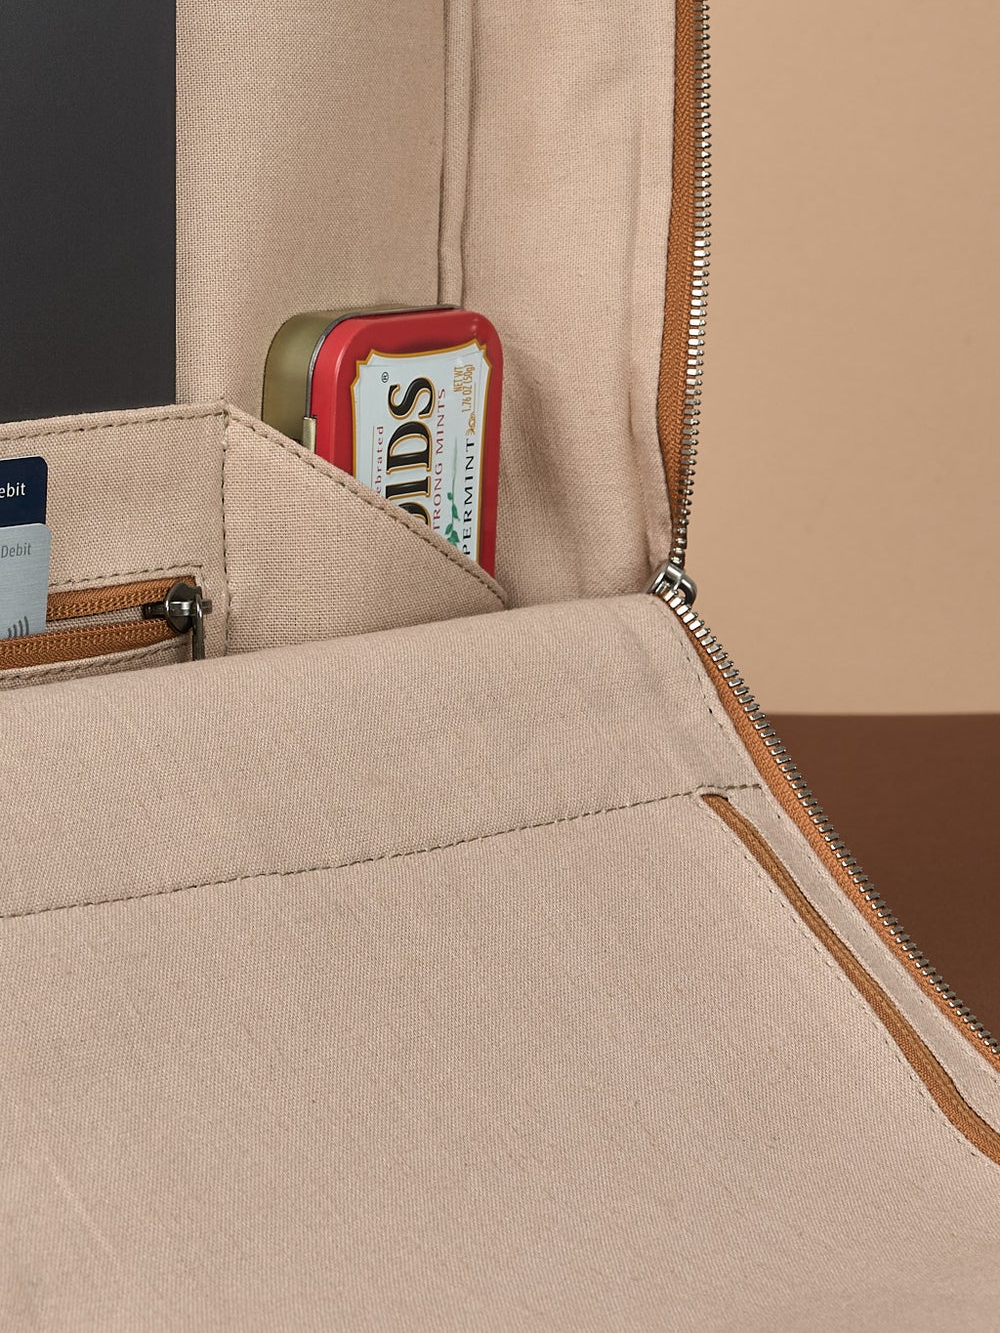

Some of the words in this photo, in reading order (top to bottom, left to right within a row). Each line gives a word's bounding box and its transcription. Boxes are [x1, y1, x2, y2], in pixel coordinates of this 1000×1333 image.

[454, 366, 464, 378] WT
[463, 364, 476, 384] (50g)
[453, 379, 463, 392] NET
[462, 385, 473, 396] OZ
[462, 396, 472, 413] 1.76
[435, 388, 447, 454] MINTS
[462, 437, 475, 555] PERMINT
[0, 542, 32, 560] Debit
